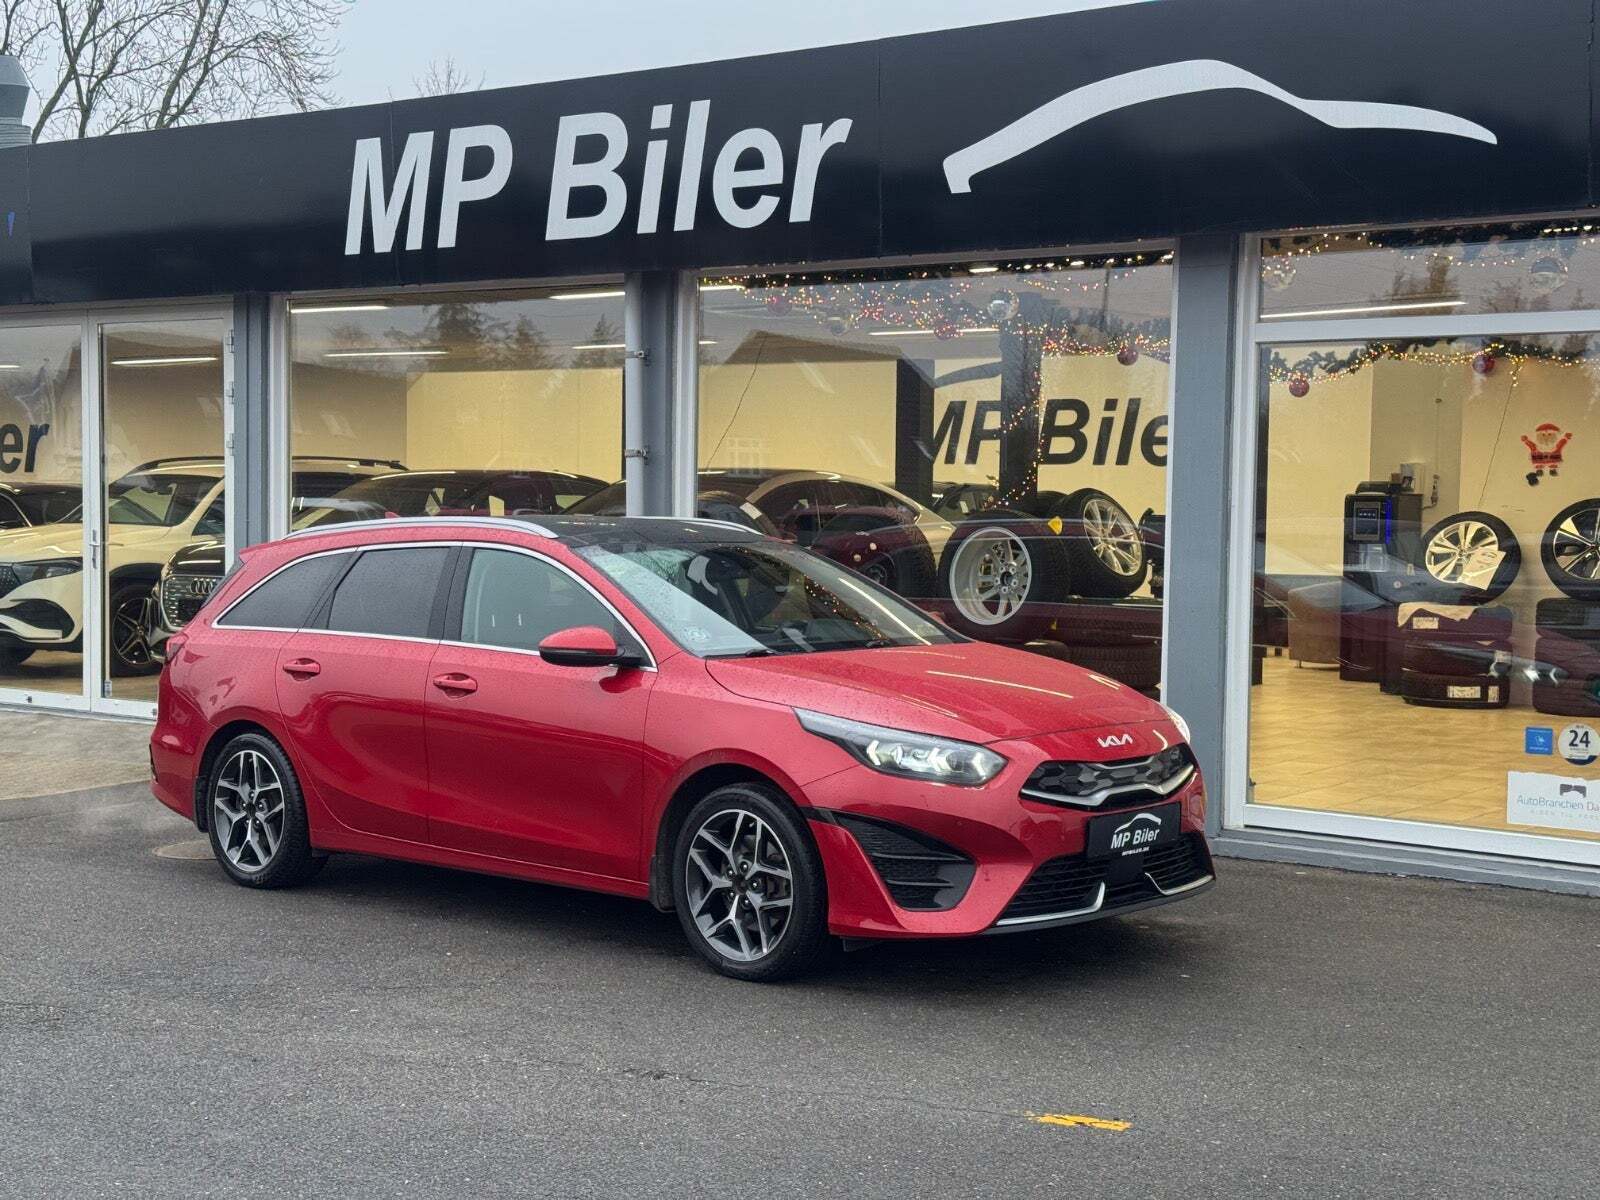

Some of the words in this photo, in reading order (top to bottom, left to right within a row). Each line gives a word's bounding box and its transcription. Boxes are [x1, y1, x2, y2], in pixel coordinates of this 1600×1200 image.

[344, 124, 513, 255] MP
[545, 99, 853, 241] Biler
[1096, 733, 1133, 748] KIA
[1568, 729, 1591, 748] 24
[1517, 795, 1584, 810] AutoBranchen
[1110, 832, 1131, 849] MP
[1132, 827, 1160, 845] Biler
